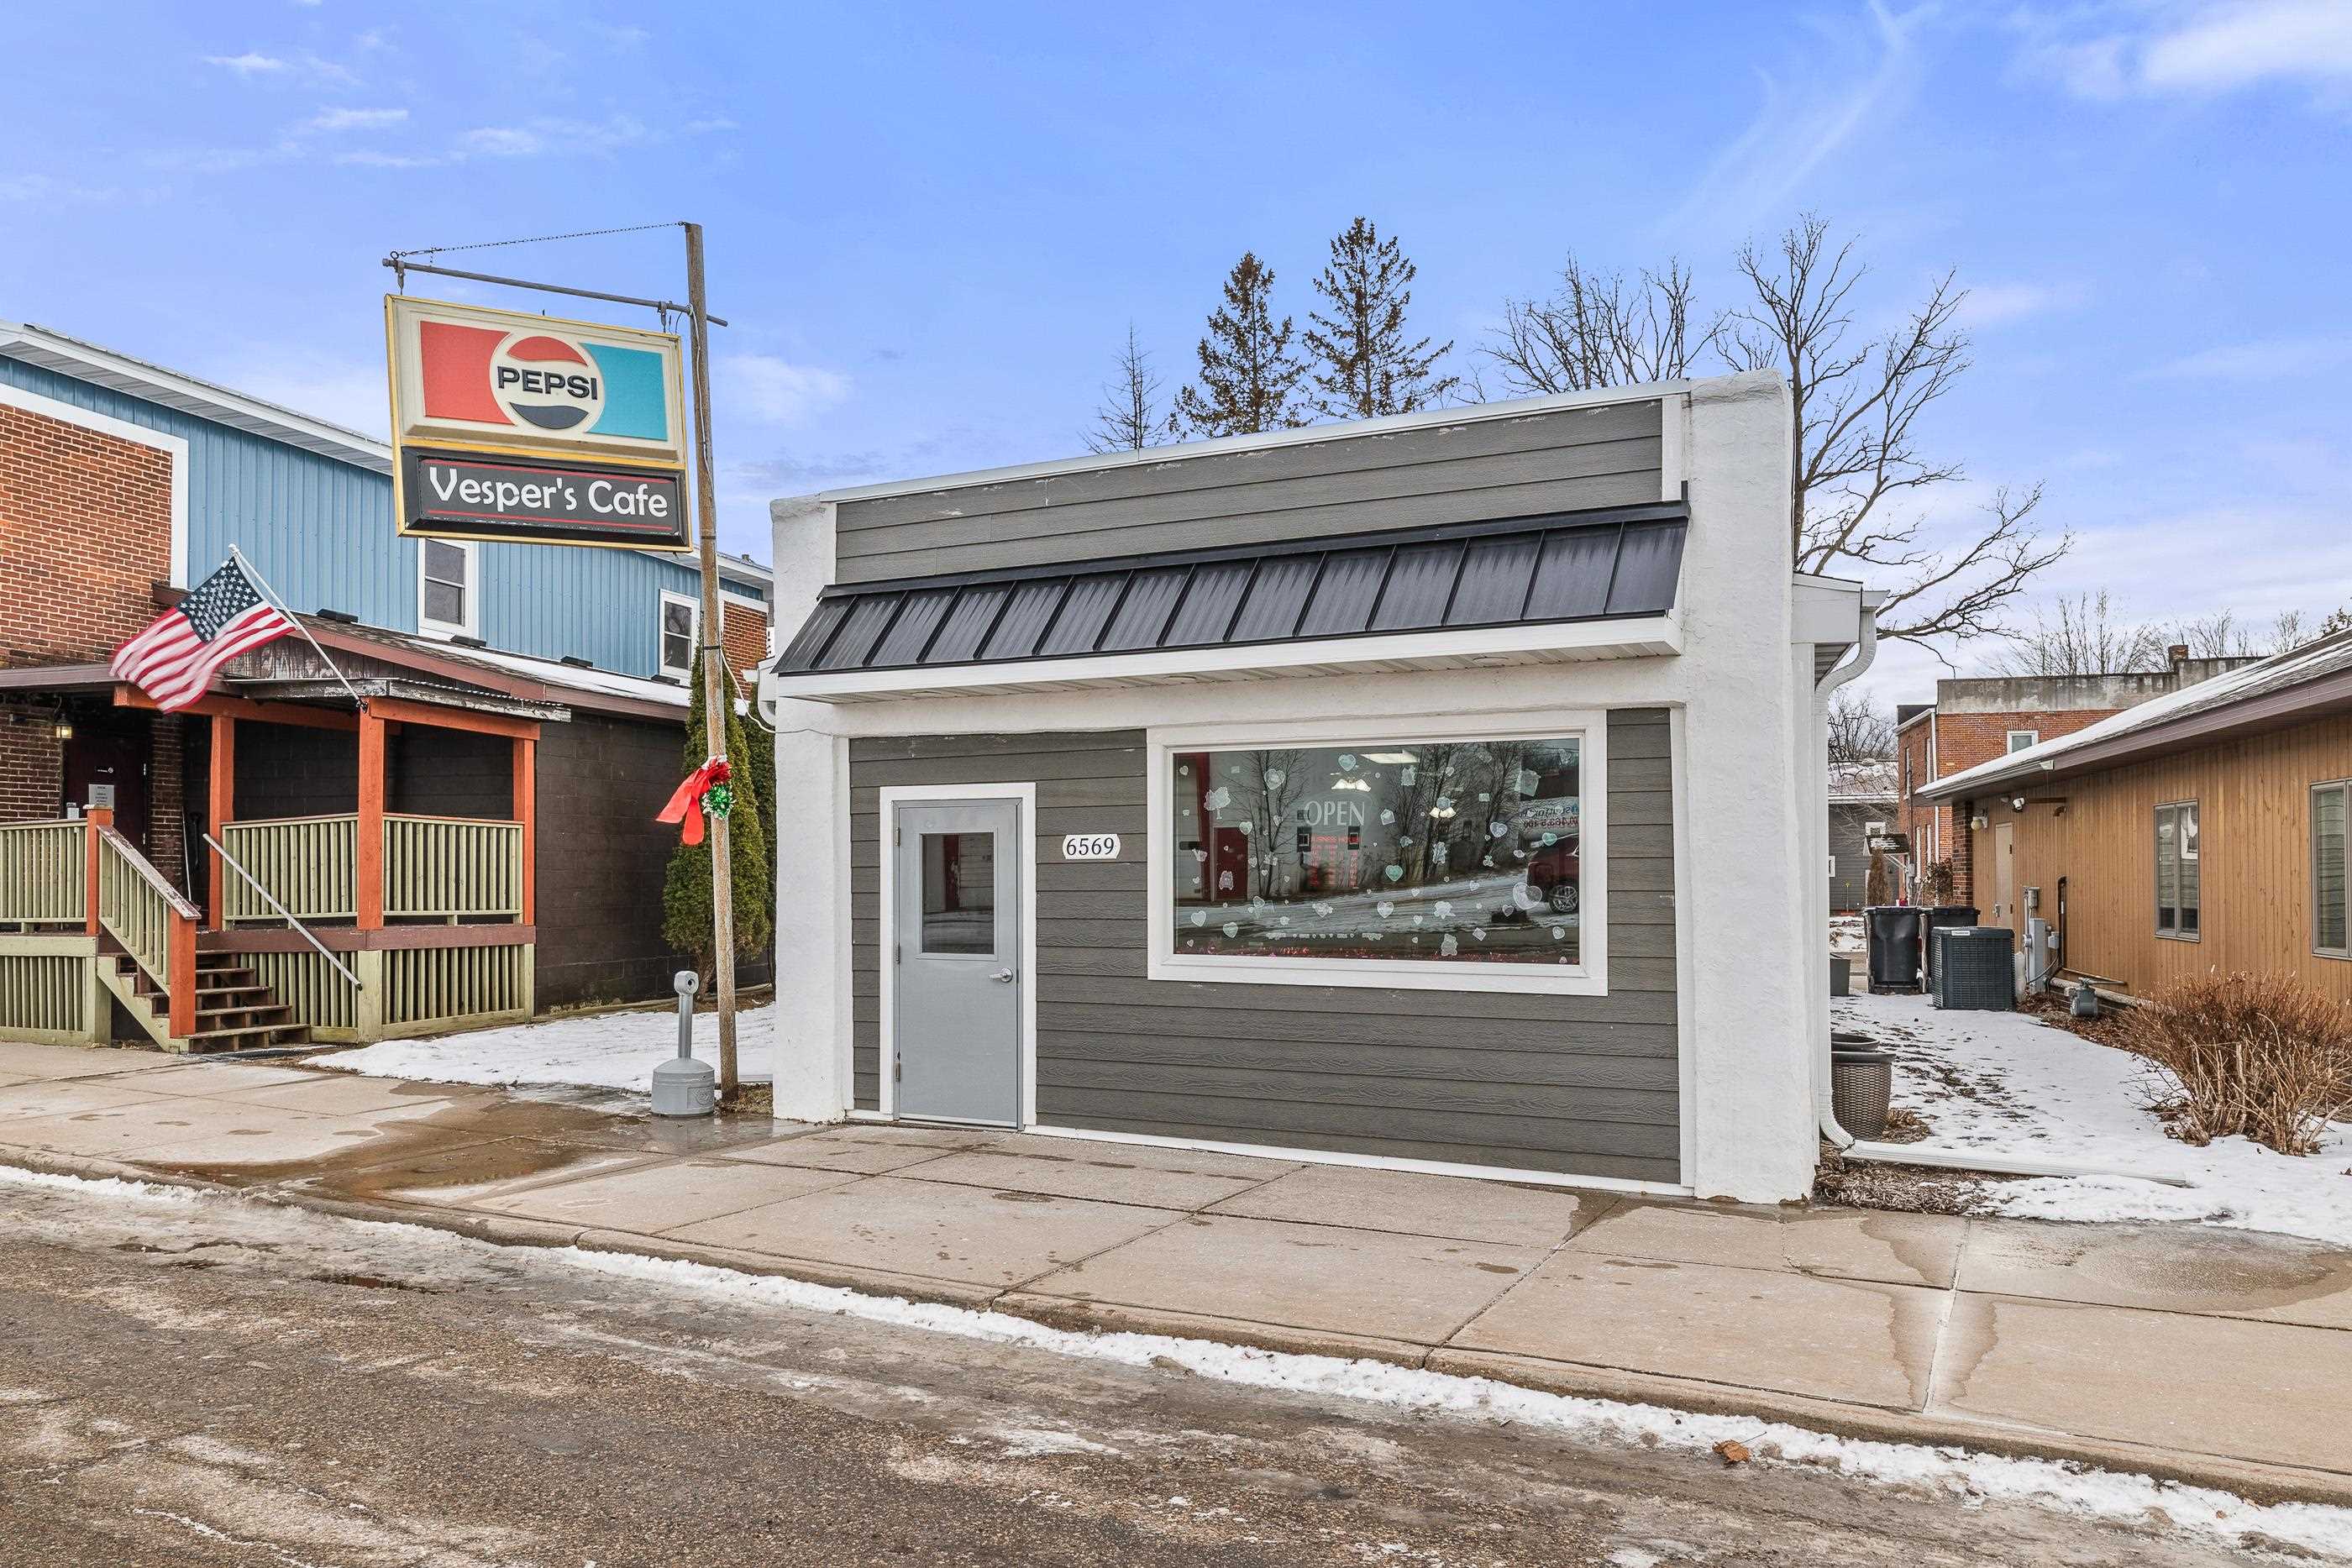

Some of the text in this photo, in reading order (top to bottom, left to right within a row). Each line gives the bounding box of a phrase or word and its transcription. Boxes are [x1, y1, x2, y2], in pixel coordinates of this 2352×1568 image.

[497, 365, 598, 401] PEPSI
[429, 467, 669, 517] Vesper's Cafe
[1304, 800, 1365, 826] OPEN
[1066, 837, 1114, 856] 6569
